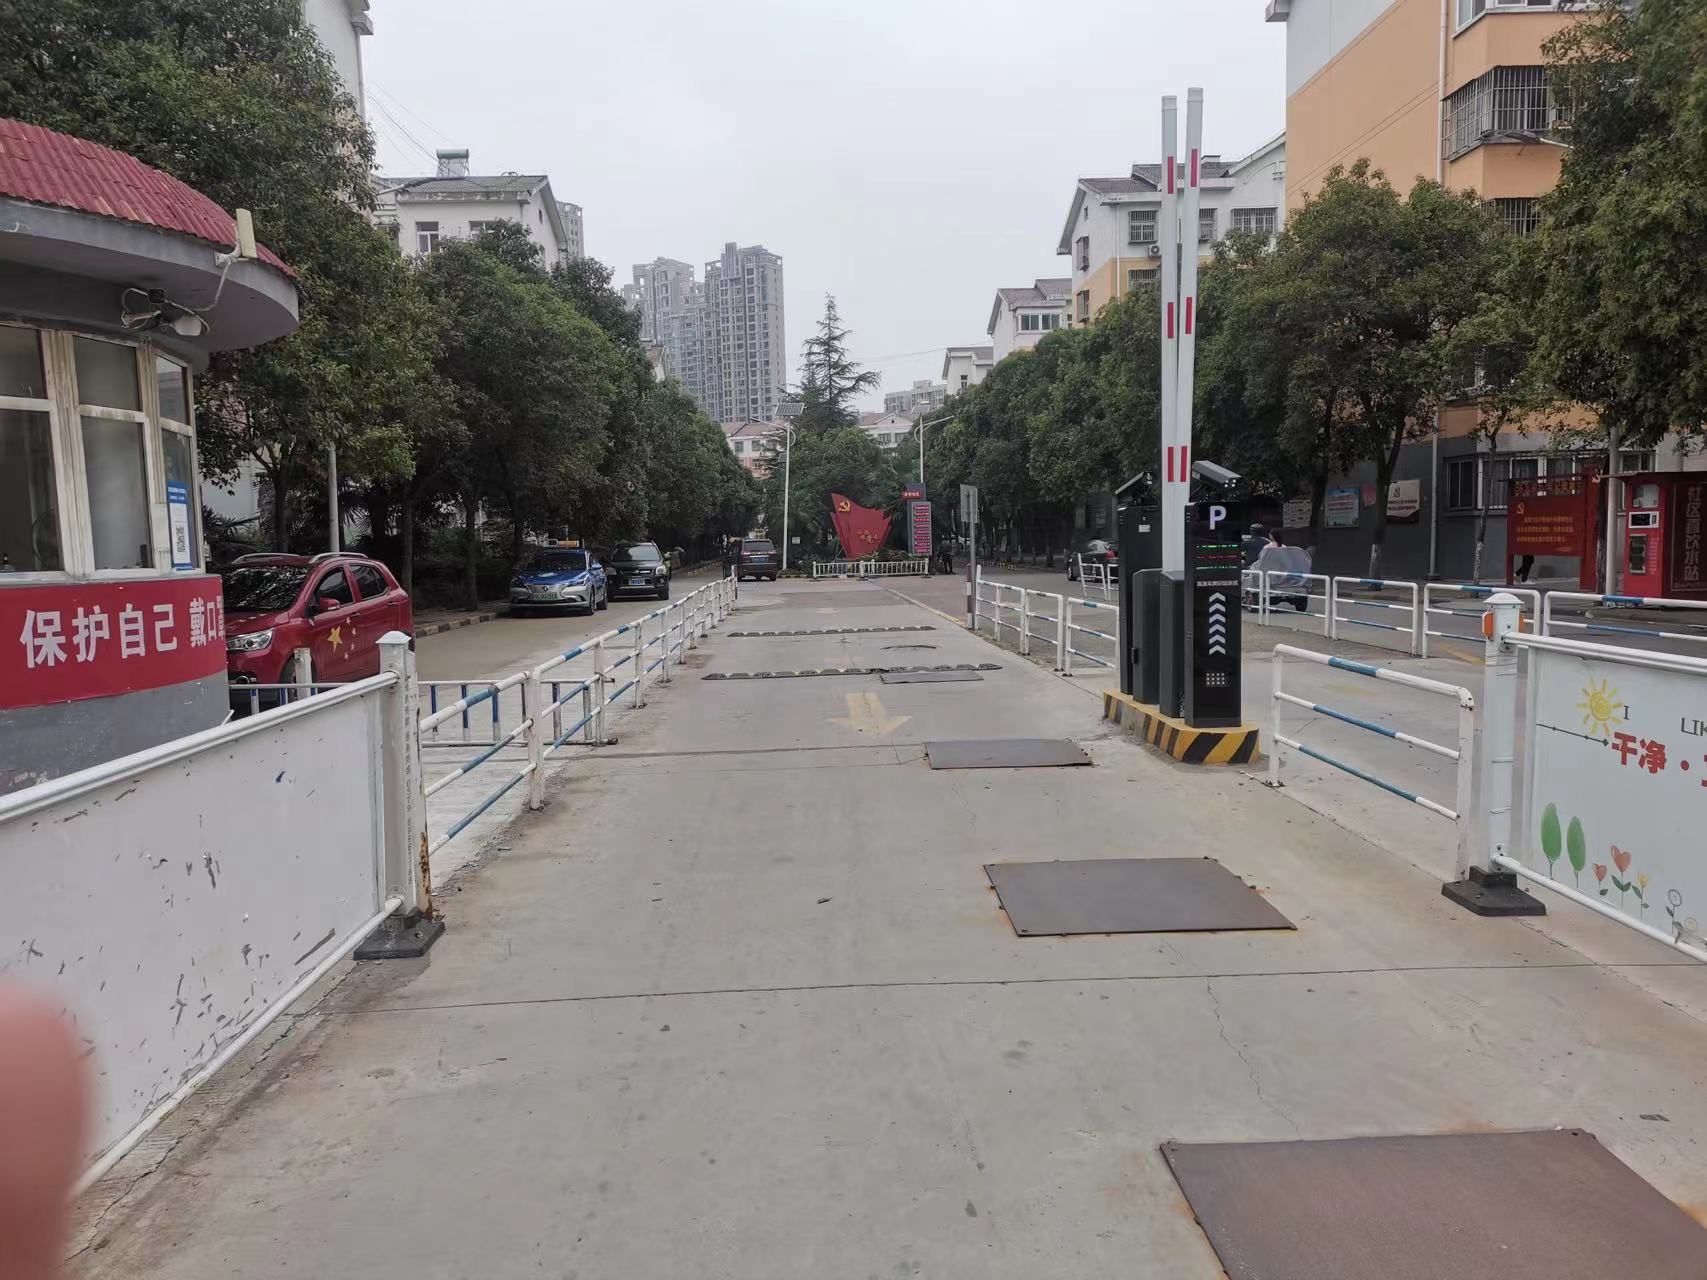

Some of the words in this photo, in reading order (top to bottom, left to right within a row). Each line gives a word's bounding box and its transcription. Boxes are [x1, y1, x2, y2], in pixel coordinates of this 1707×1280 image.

[1209, 505, 1227, 530] P
[20, 603, 177, 669] 保护自己
